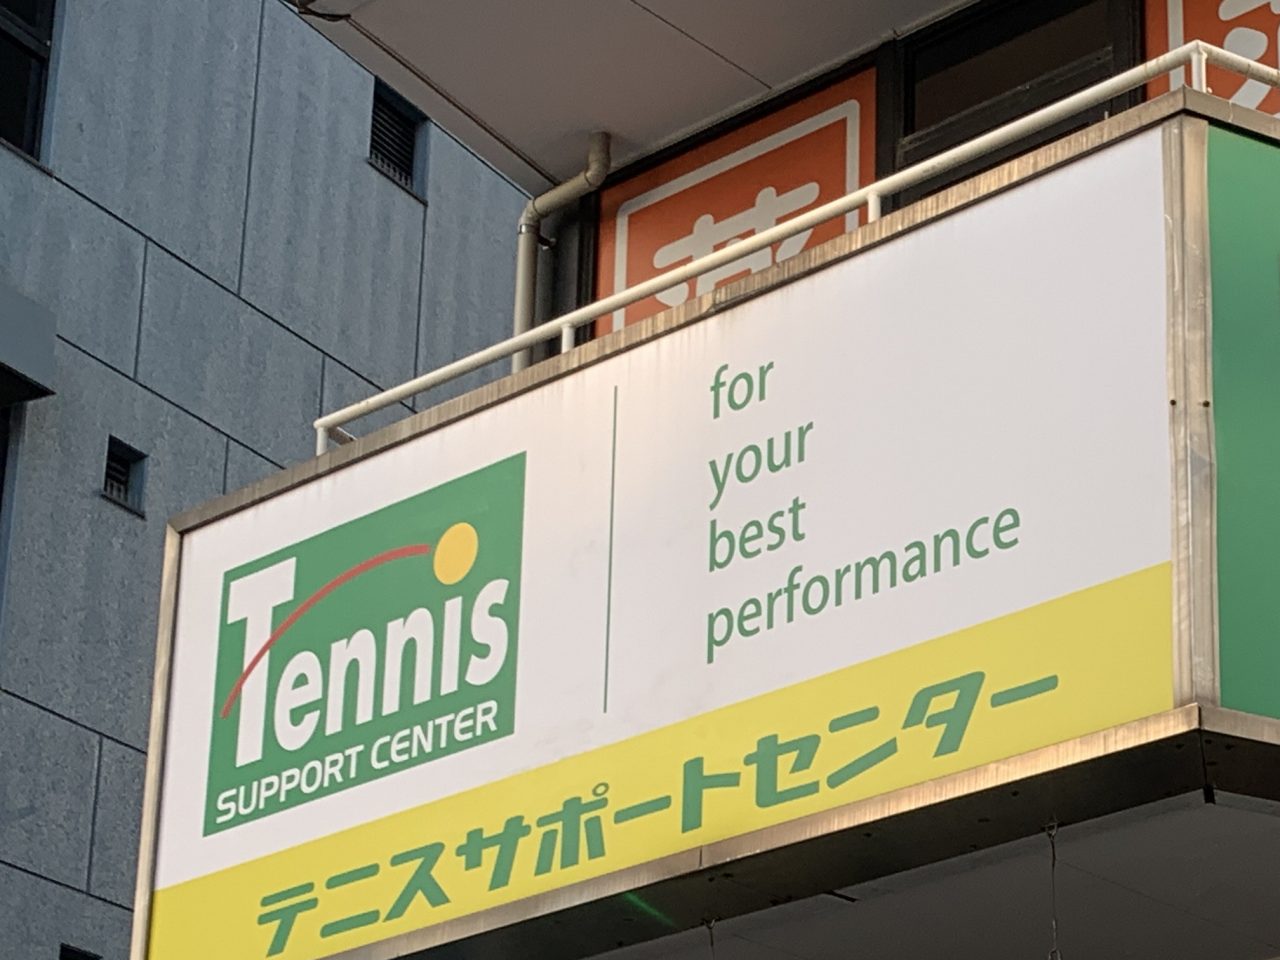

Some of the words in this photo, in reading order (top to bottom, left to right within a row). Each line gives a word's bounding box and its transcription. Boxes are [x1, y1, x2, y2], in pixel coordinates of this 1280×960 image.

[710, 361, 774, 420] for
[708, 421, 813, 511] your
[706, 507, 1021, 664] performance
[708, 496, 807, 573] best
[227, 555, 510, 769] Tennis
[215, 744, 364, 825] SUPPORT
[370, 699, 498, 770] CENTER
[256, 669, 1059, 956] テニスサポートセンター
